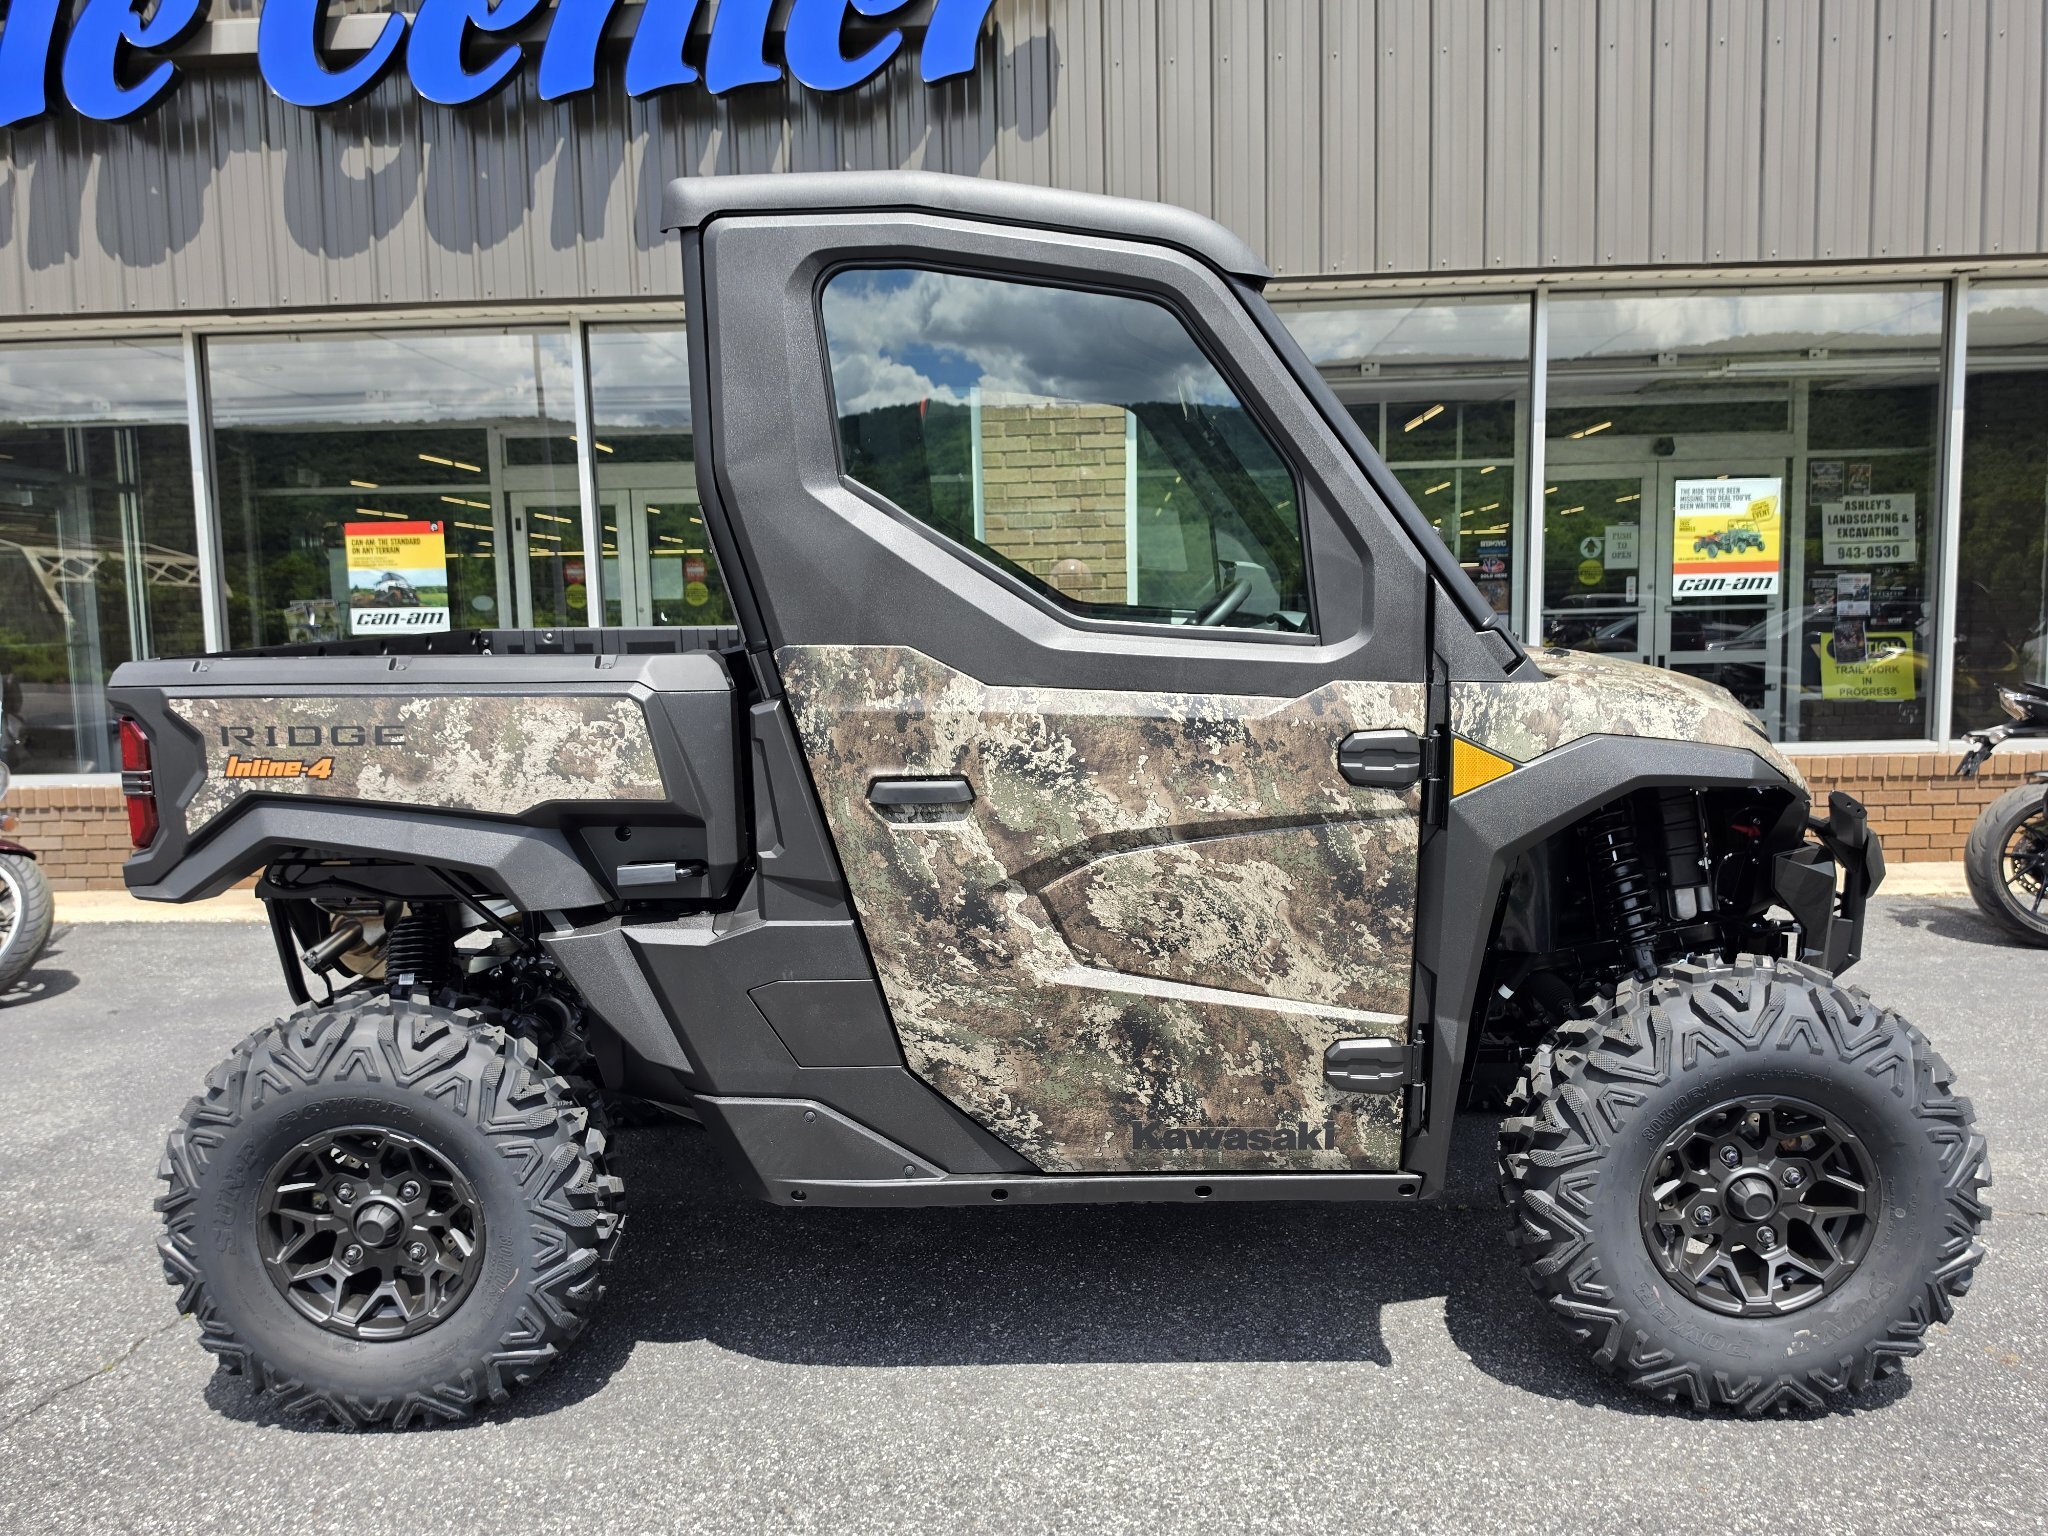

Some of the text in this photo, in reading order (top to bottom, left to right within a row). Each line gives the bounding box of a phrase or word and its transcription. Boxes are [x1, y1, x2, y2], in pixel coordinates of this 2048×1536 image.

[1844, 499, 1891, 511] ASHLEY'S
[1828, 513, 1909, 525] LANDSCAPING &
[1612, 532, 1632, 540] PUSH
[1837, 526, 1899, 539] EXCAVATING
[378, 538, 388, 546] THE
[390, 537, 420, 546] STANDARD
[376, 546, 400, 554] TERRAIN
[1611, 552, 1632, 560] OPEN
[1837, 545, 1900, 559] 943-0530
[1678, 577, 1773, 592] can-am
[357, 612, 444, 625] can-am
[1835, 665, 1864, 675] TRAIL
[1862, 677, 1872, 685] IN
[1840, 687, 1897, 697] PROGRESS
[220, 725, 406, 747] RIDGE
[224, 754, 335, 780] Inline-4
[1132, 1120, 1335, 1150] Kawasaki
